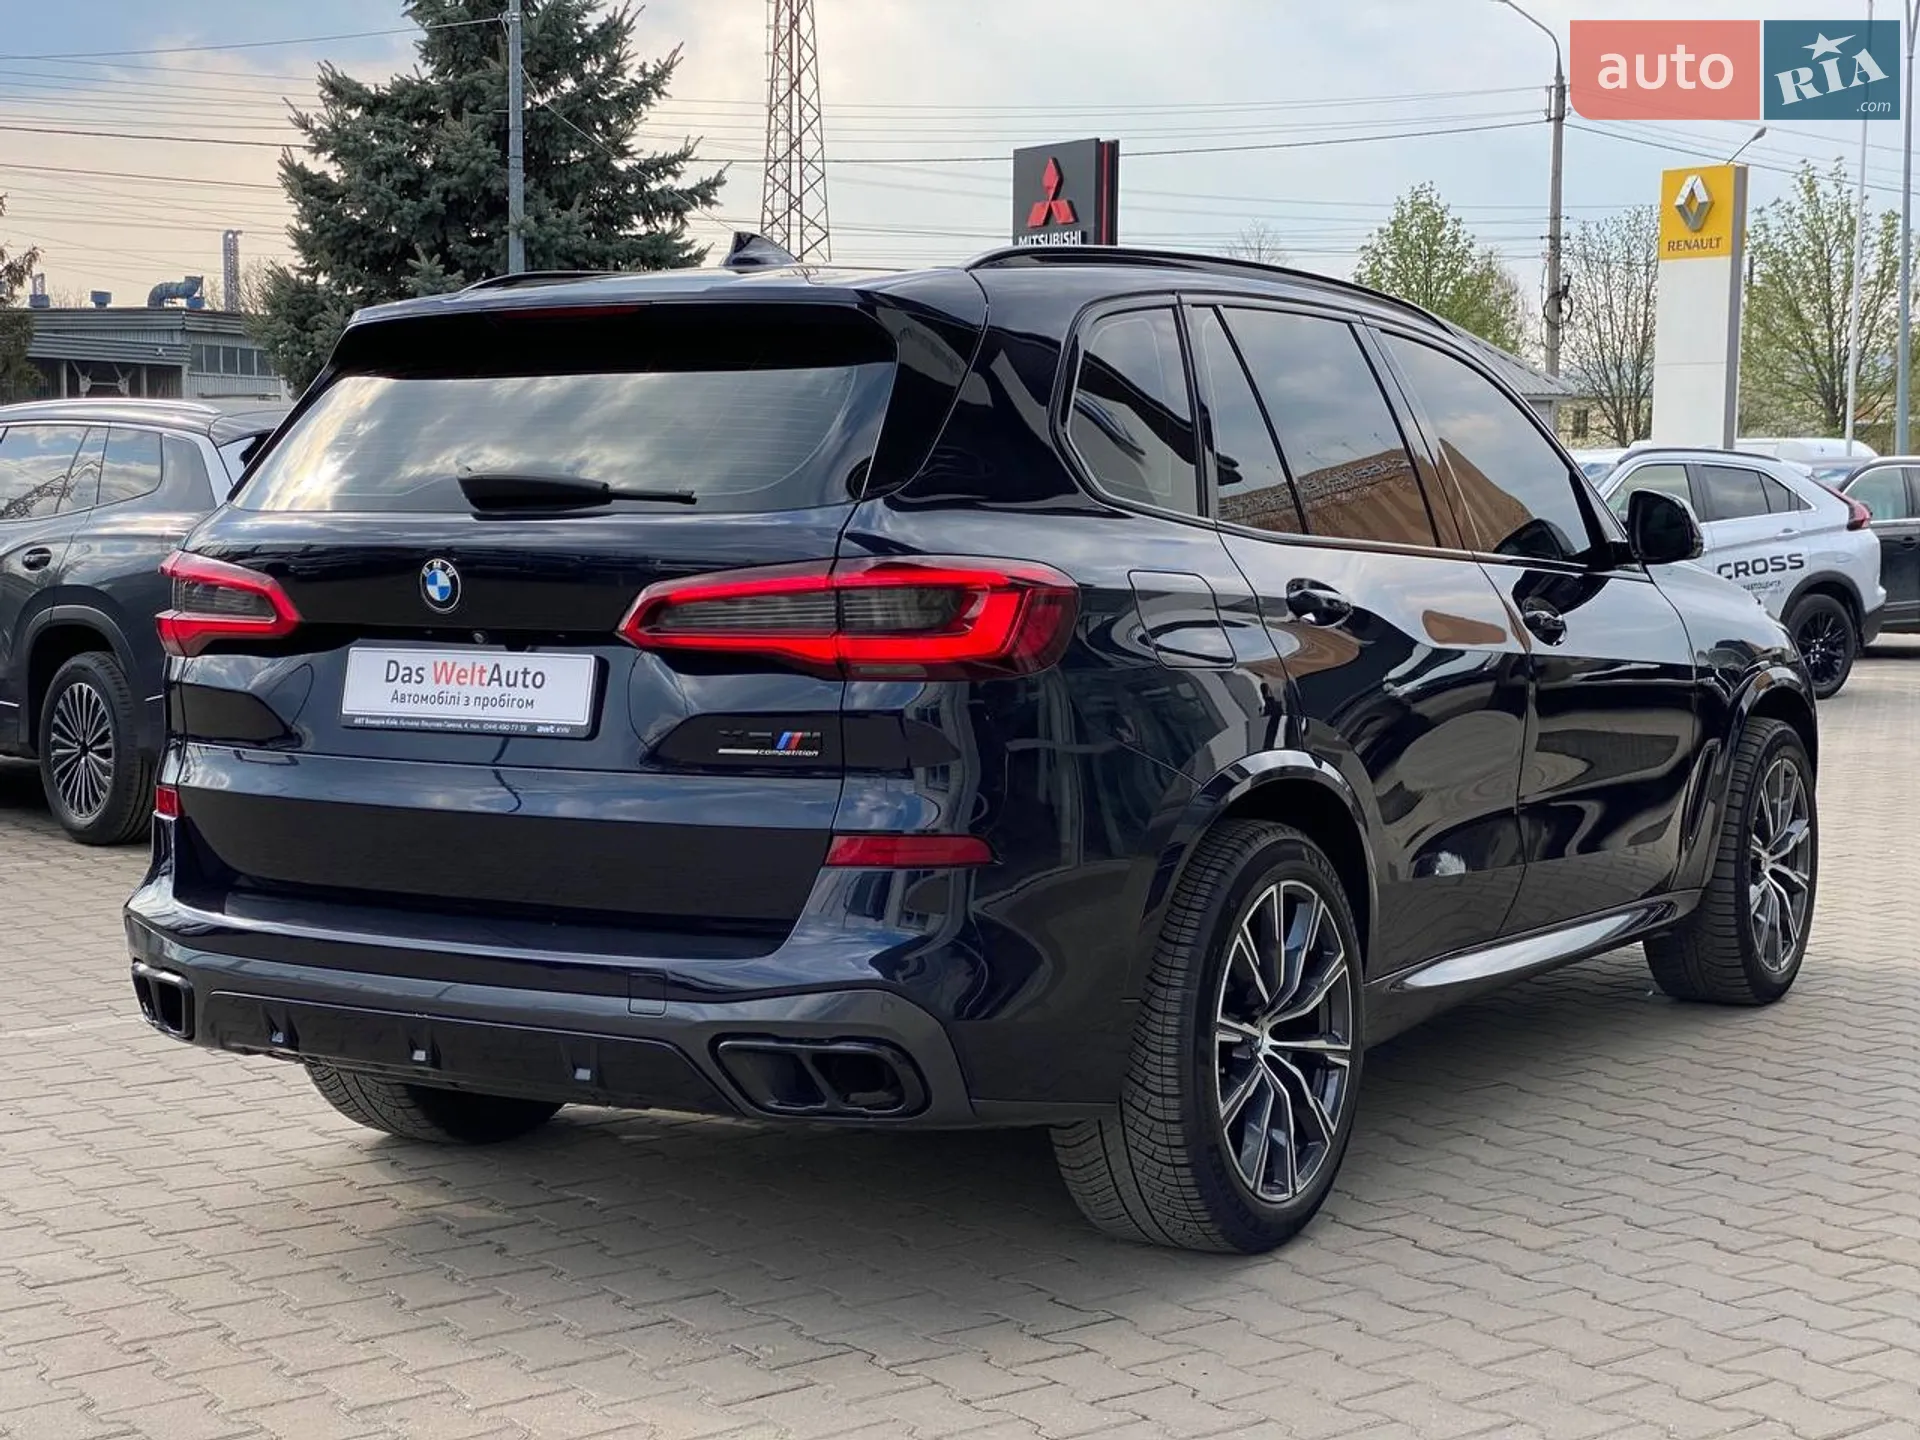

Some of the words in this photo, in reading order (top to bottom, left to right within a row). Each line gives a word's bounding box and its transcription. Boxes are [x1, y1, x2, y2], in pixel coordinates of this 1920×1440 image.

[1018, 230, 1082, 246] MITSUBISHI
[1667, 237, 1722, 252] RENAULT
[1717, 553, 1804, 580] CROSS
[385, 659, 425, 685] Das
[433, 660, 546, 689] WeltAuto
[390, 689, 461, 706] Автомобілі
[463, 696, 470, 707] з
[473, 692, 535, 711] пробігом
